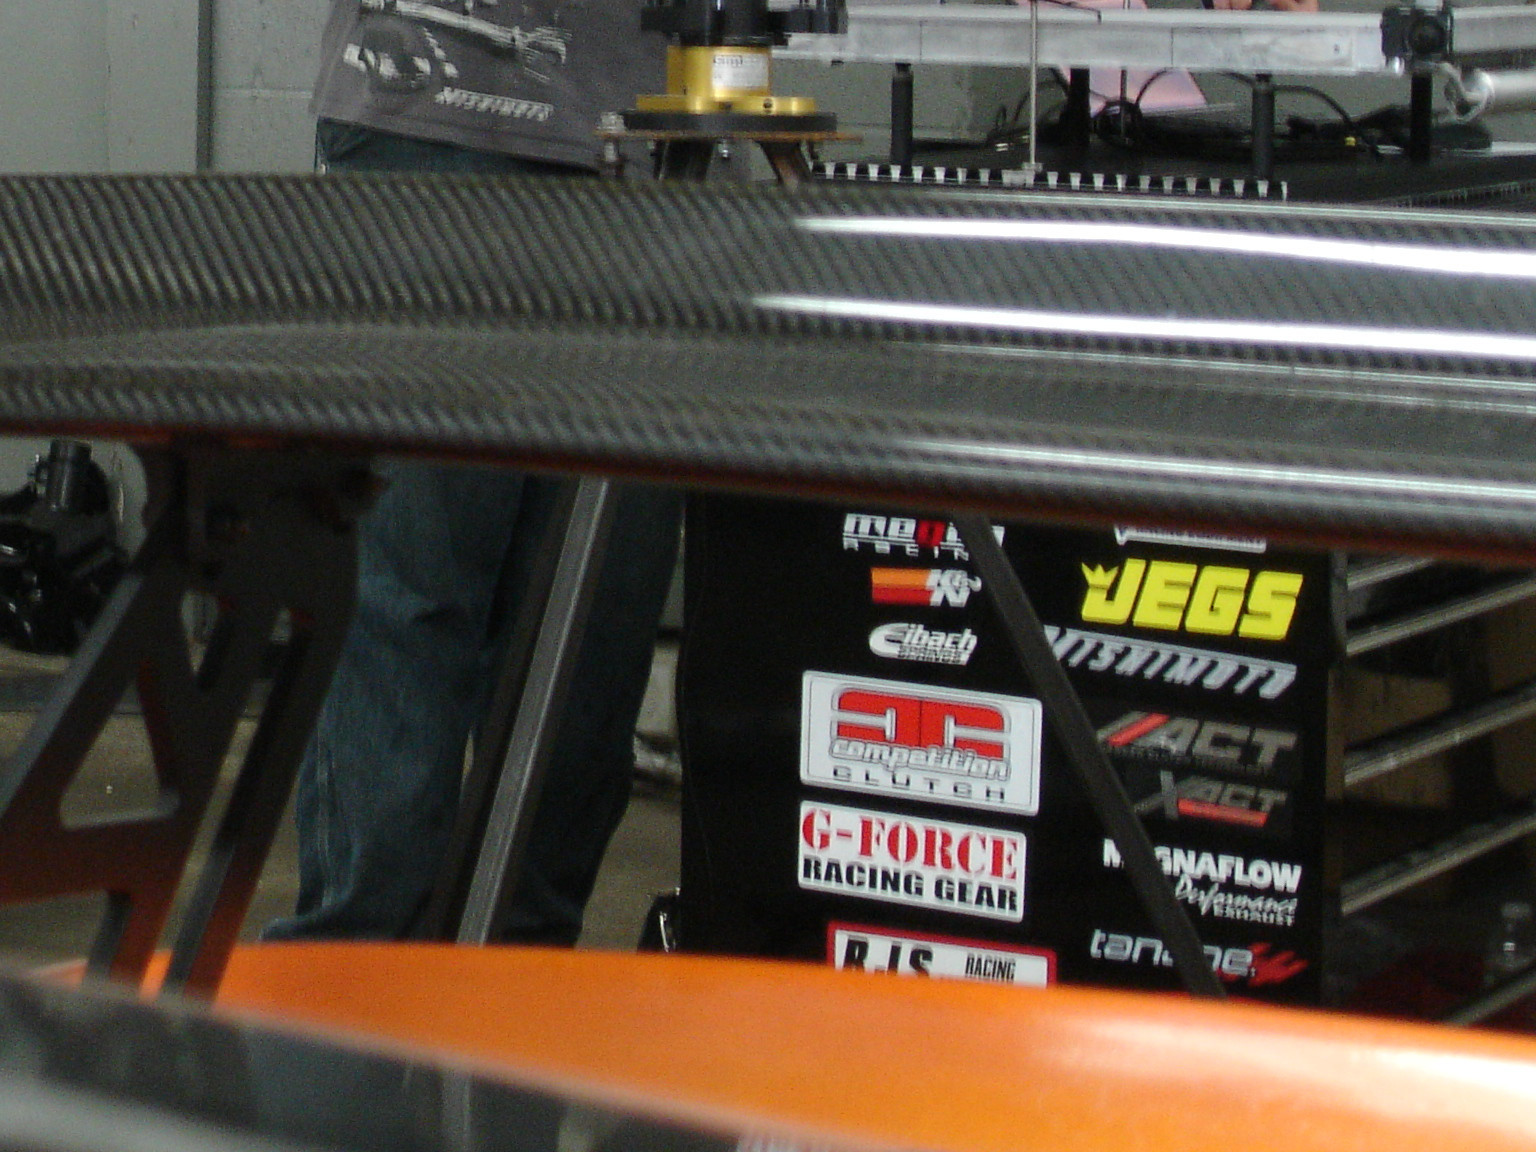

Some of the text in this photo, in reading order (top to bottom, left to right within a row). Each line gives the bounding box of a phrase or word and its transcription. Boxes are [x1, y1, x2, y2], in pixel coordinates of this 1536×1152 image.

[1081, 557, 1304, 641] JEGS
[831, 765, 1006, 802] CLUTCH
[801, 807, 1018, 881] G-FORCE
[1102, 837, 1303, 894] MGNAFLOW
[802, 856, 1018, 913] RACING GEAR
[964, 952, 1017, 984] RACING
